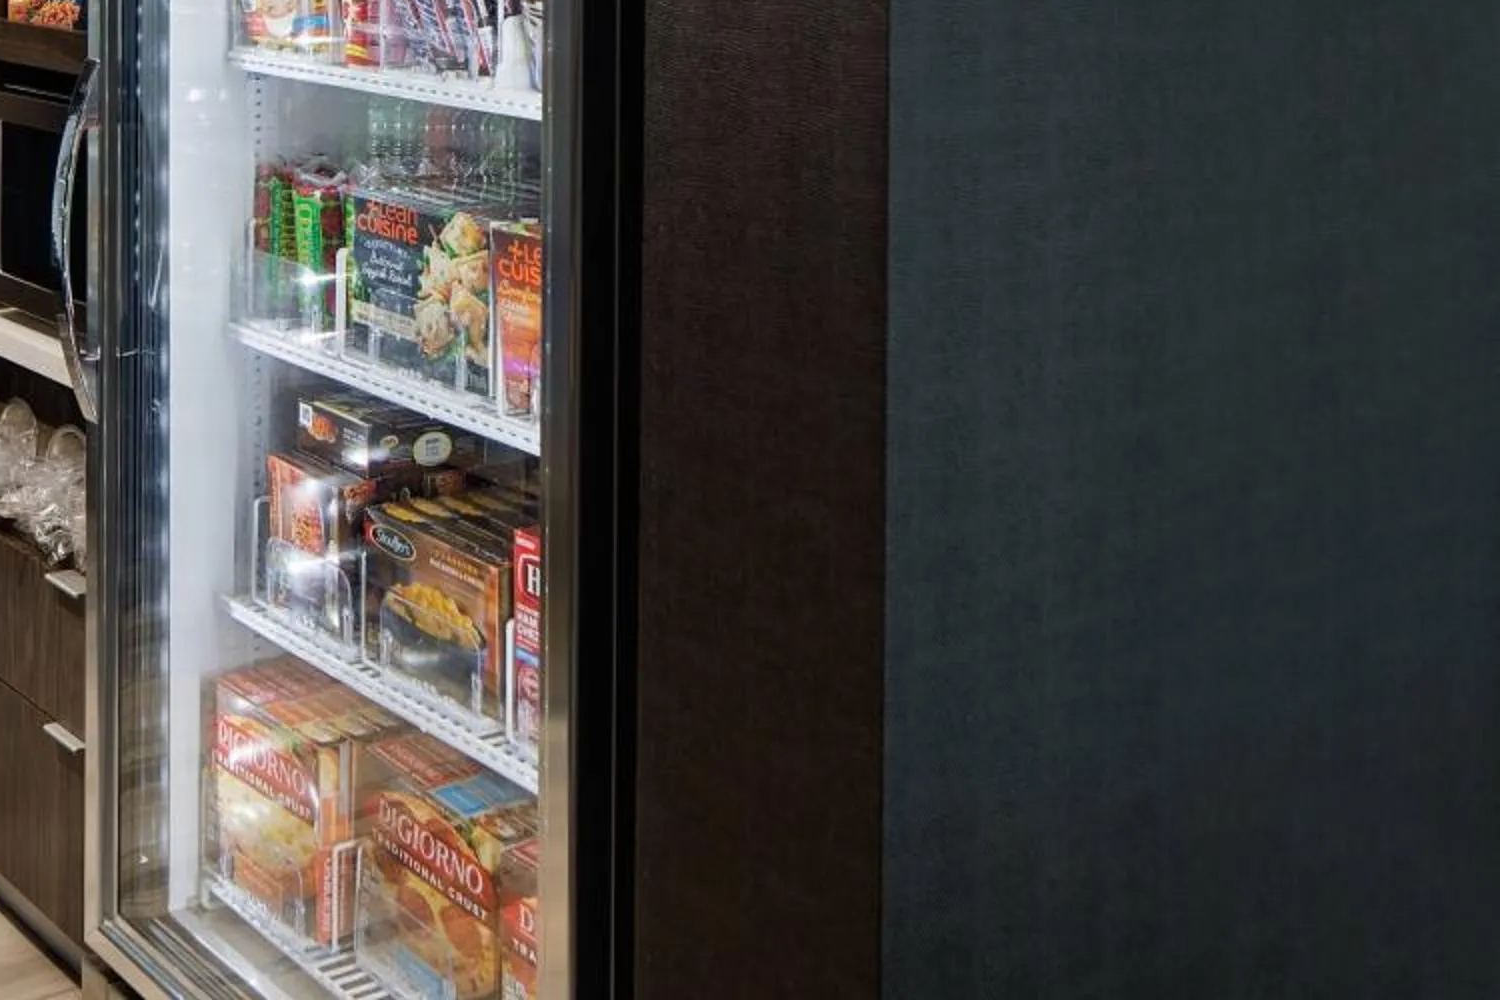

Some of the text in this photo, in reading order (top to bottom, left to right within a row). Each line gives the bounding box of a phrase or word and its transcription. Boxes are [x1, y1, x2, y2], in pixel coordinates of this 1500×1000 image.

[218, 719, 306, 795] DIORNO
[372, 826, 444, 892] TRADITIONAL
[446, 885, 488, 921] CRUST
[380, 799, 484, 896] DIGIORNO
